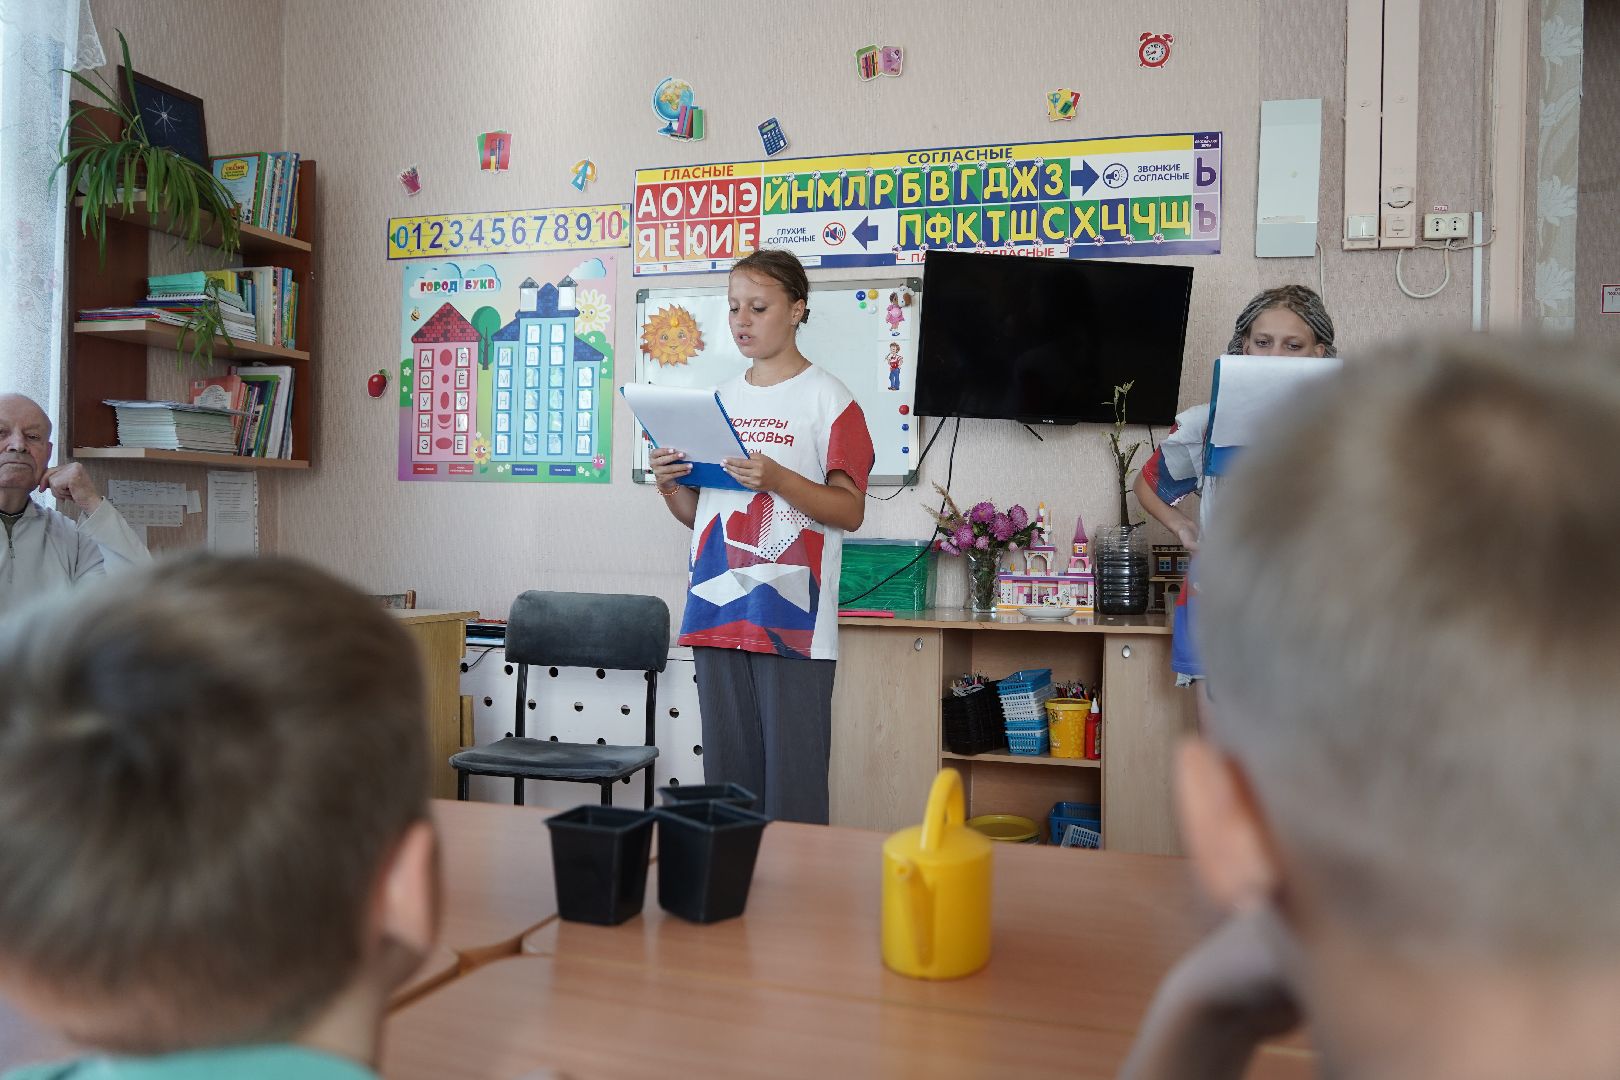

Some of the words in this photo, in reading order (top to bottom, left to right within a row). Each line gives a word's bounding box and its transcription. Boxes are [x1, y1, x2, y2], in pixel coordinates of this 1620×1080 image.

[908, 148, 1012, 164] СОГЛАСНЫЕ
[663, 165, 734, 180] ГЛАСНЫЕ
[1138, 164, 1180, 172] ЗВОНКИЕ
[1196, 157, 1217, 186] Ь
[1134, 172, 1190, 182] СОГЛАСНЫЕ
[1195, 203, 1216, 232] Ъ
[396, 226, 408, 248] 0
[412, 223, 422, 250] 1
[429, 222, 444, 248] 2
[448, 220, 464, 248] 3
[469, 220, 484, 246] 4
[490, 218, 506, 246] 5
[512, 216, 526, 244] 6
[533, 216, 548, 242] 7
[554, 214, 568, 242] 8
[576, 212, 592, 240] 9
[596, 210, 623, 240] 10
[768, 234, 816, 244] СОГЛАСНЫЕ
[974, 247, 1055, 258] ЛАСНЫЕ
[420, 280, 458, 293] ГОРОД
[422, 354, 430, 364] А
[456, 440, 464, 450] Е
[736, 431, 794, 446] СКОВЬЯ
